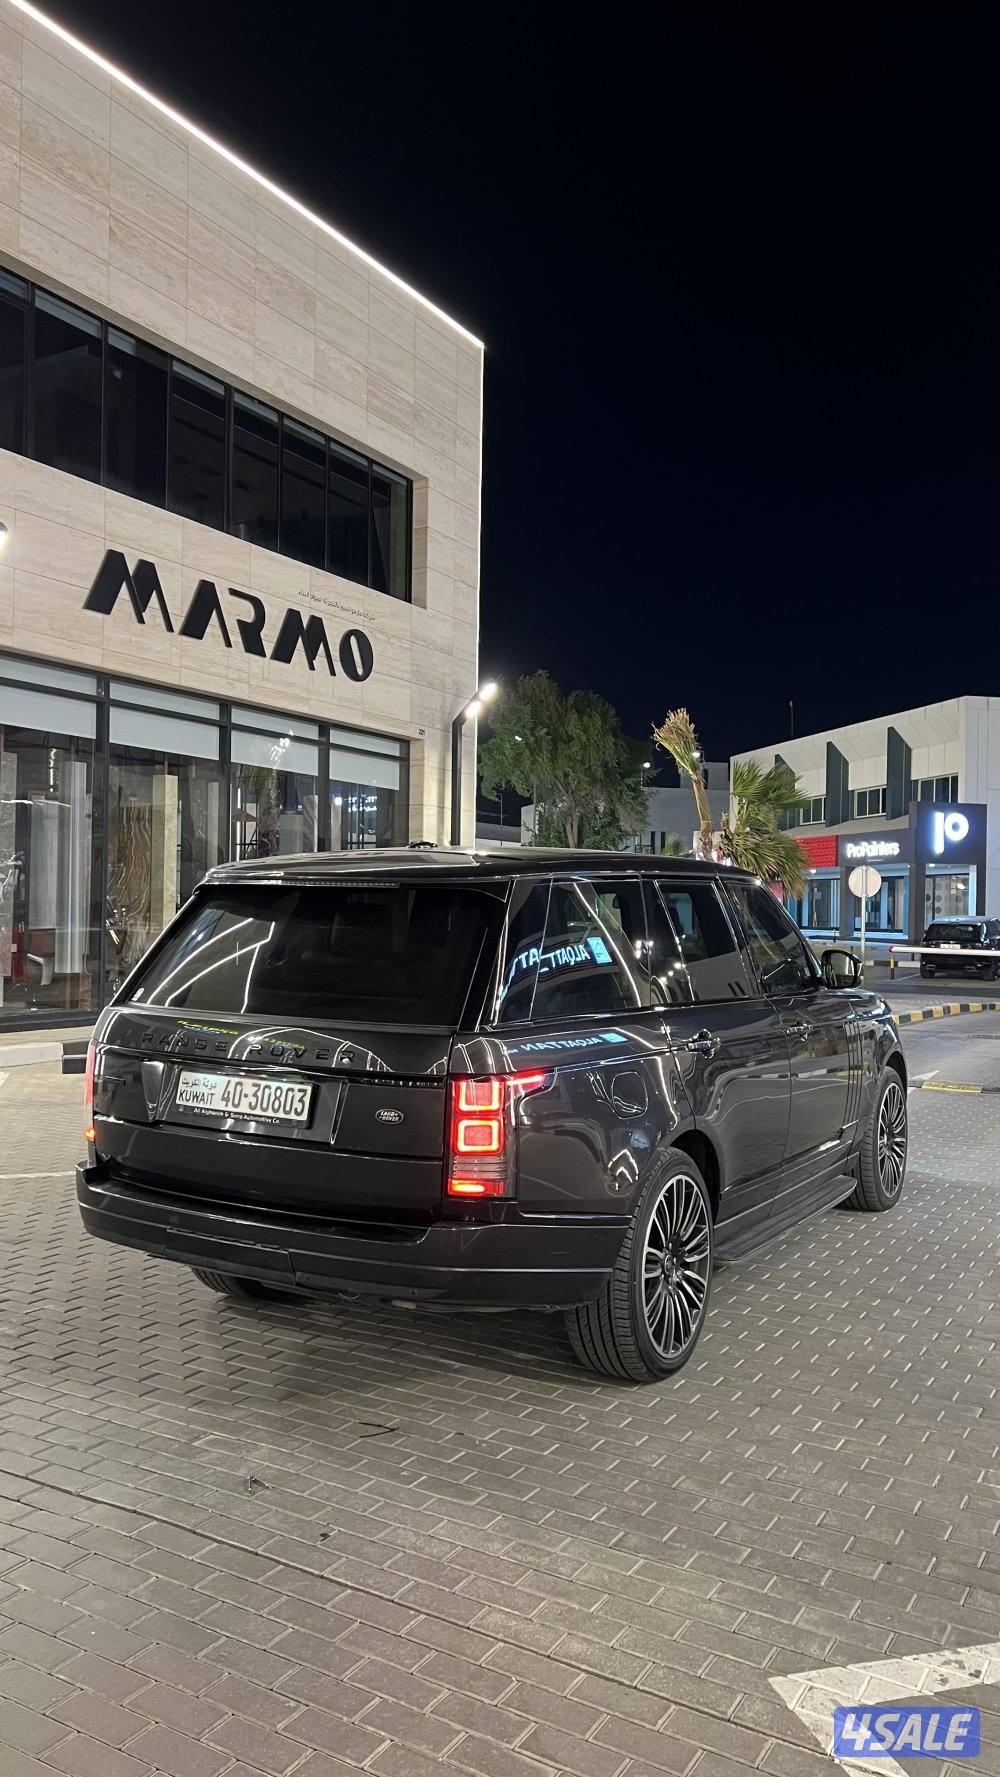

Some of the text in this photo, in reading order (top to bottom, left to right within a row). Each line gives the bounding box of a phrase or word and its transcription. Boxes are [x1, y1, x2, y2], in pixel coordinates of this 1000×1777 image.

[82, 548, 374, 682] MARMO
[142, 1033, 229, 1053] RANGE
[249, 1043, 356, 1063] ROVER
[178, 1089, 215, 1105] KUWAIT
[220, 1079, 308, 1117] 40-30803
[230, 1112, 243, 1120] Sons
[244, 1114, 272, 1123] Automotive
